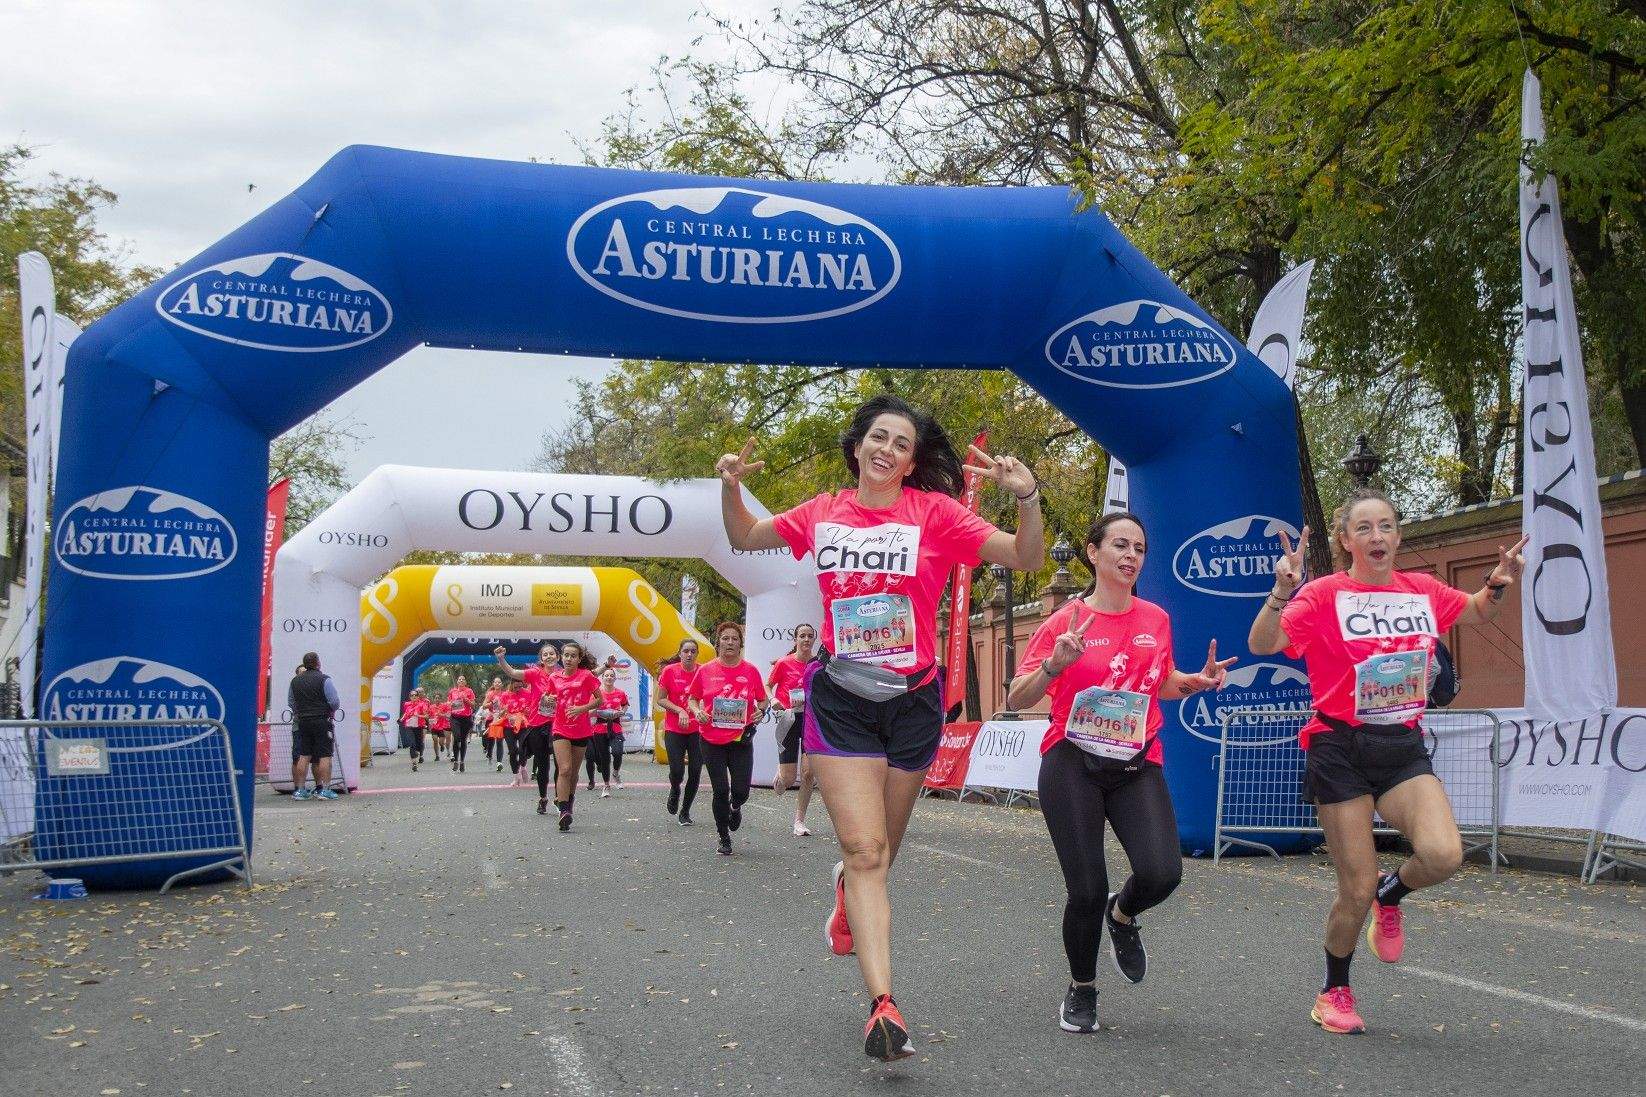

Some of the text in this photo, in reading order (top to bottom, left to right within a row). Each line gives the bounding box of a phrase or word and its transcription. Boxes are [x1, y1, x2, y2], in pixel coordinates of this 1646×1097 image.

[647, 218, 866, 246] CENTRAL LECHERA
[592, 218, 877, 291] ASTURIANA
[213, 279, 371, 306] CENTRAL LECHERA
[169, 282, 373, 334] ASTURIANA
[1092, 328, 1216, 342] CENTRAL LECHERA
[1062, 334, 1229, 367] ASTURIANA
[458, 488, 673, 536] OYSHO
[83, 517, 221, 533] CENTRAL LECHERA
[60, 520, 226, 561] ASTURIANA
[318, 530, 389, 549] OYSHO
[1210, 542, 1264, 554] CENTRAL
[817, 546, 909, 572] Chari
[1185, 548, 1280, 580] ASTURI
[481, 584, 513, 597] IMD
[283, 618, 348, 633] OYSHO
[863, 627, 892, 642] 016
[1346, 611, 1431, 636] Chari
[67, 688, 208, 700] CENTRAL LECHERA
[1216, 688, 1311, 703] CENTRAL LECHER
[1380, 683, 1405, 698] 016
[50, 691, 212, 728] ASTURIANA
[1190, 697, 1312, 727] ASTURIAN
[1093, 716, 1122, 732] 016
[980, 730, 1026, 758] OYSHO
